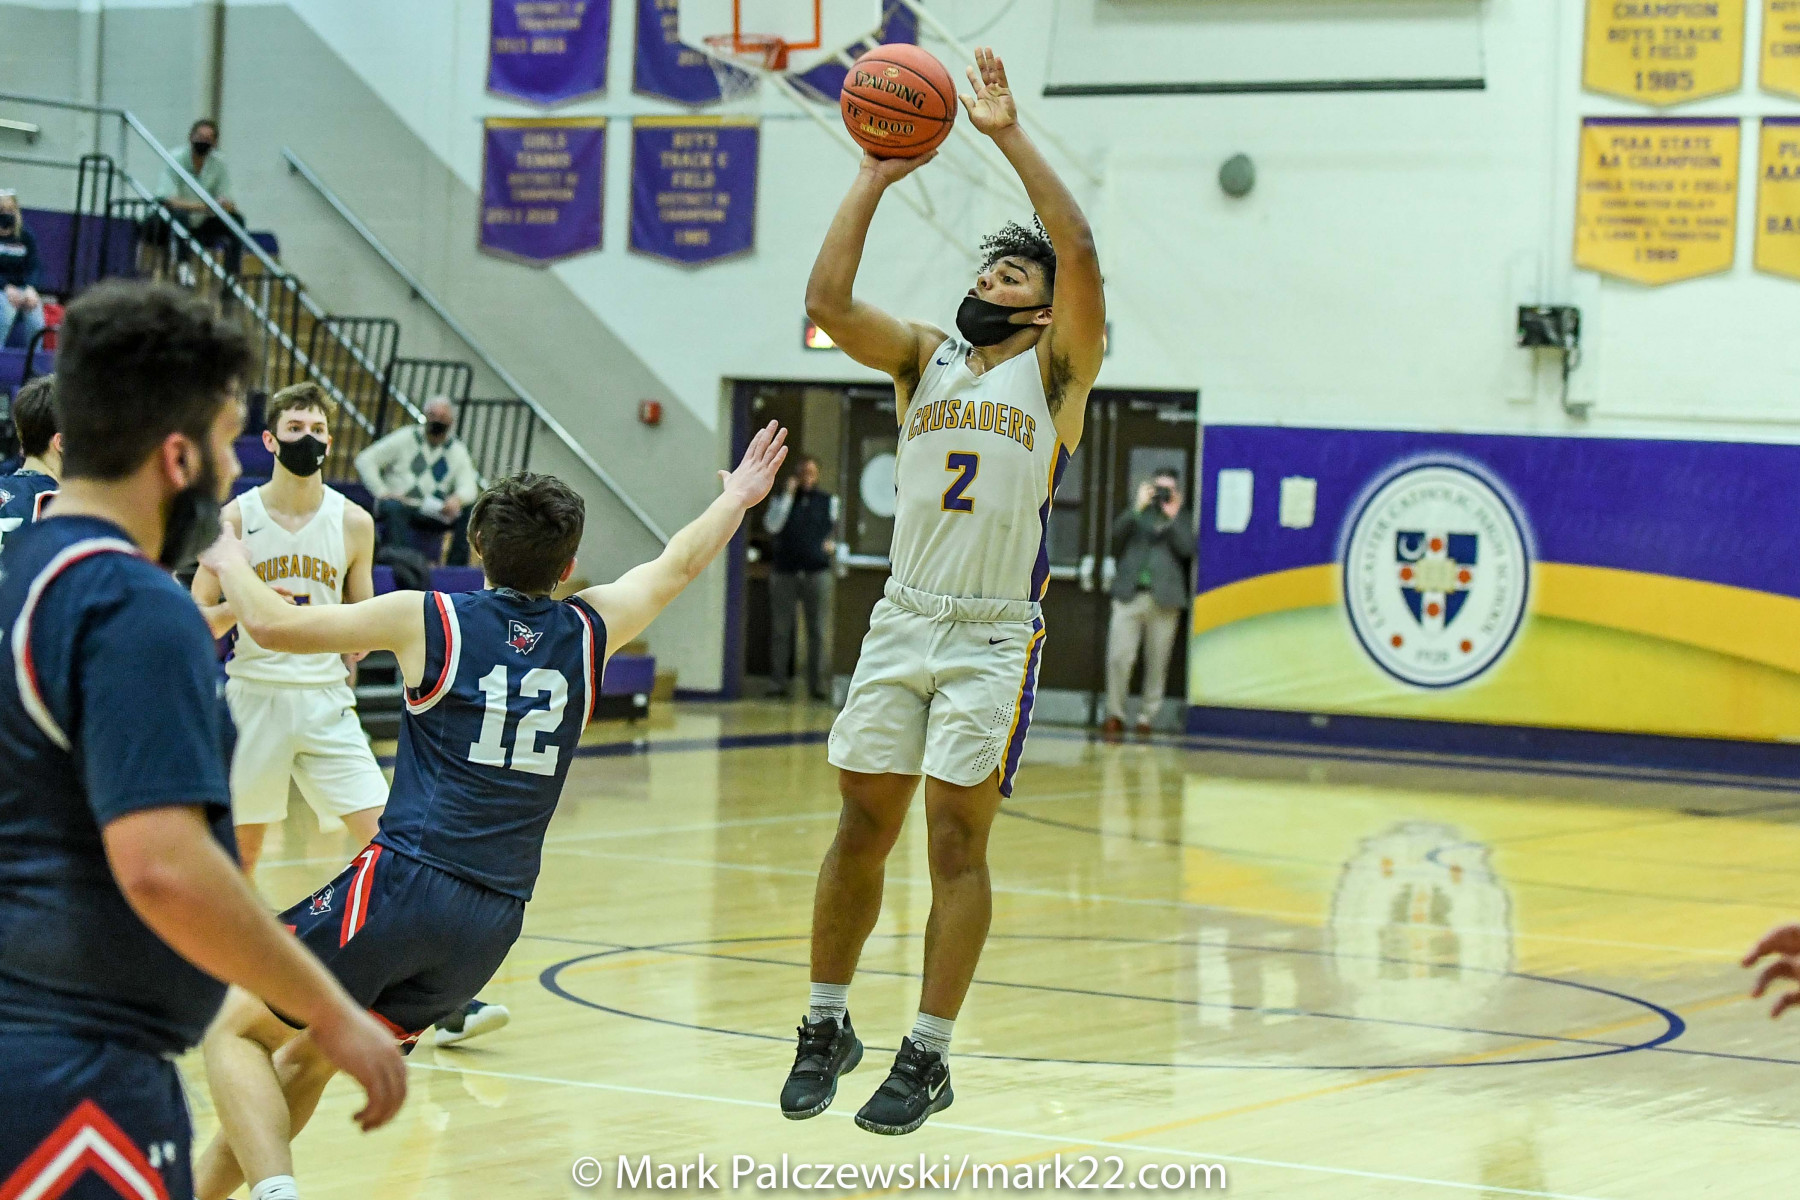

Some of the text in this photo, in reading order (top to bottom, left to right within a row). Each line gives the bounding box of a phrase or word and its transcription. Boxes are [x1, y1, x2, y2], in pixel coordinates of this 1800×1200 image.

[1613, 3, 1718, 19] CHAMPION
[1663, 27, 1721, 42] TRACK
[1649, 45, 1697, 60] FIELD
[852, 70, 926, 110] SPALDING
[846, 101, 914, 135] TF 1000
[1660, 136, 1712, 150] STATE
[660, 152, 712, 168] TRACK
[1628, 154, 1721, 169] CHAMPION
[671, 171, 716, 188] FIELD
[907, 398, 1036, 452] CRUSADERS
[941, 450, 981, 514] 2
[253, 554, 337, 592] RUSADERS
[468, 664, 568, 776] 12
